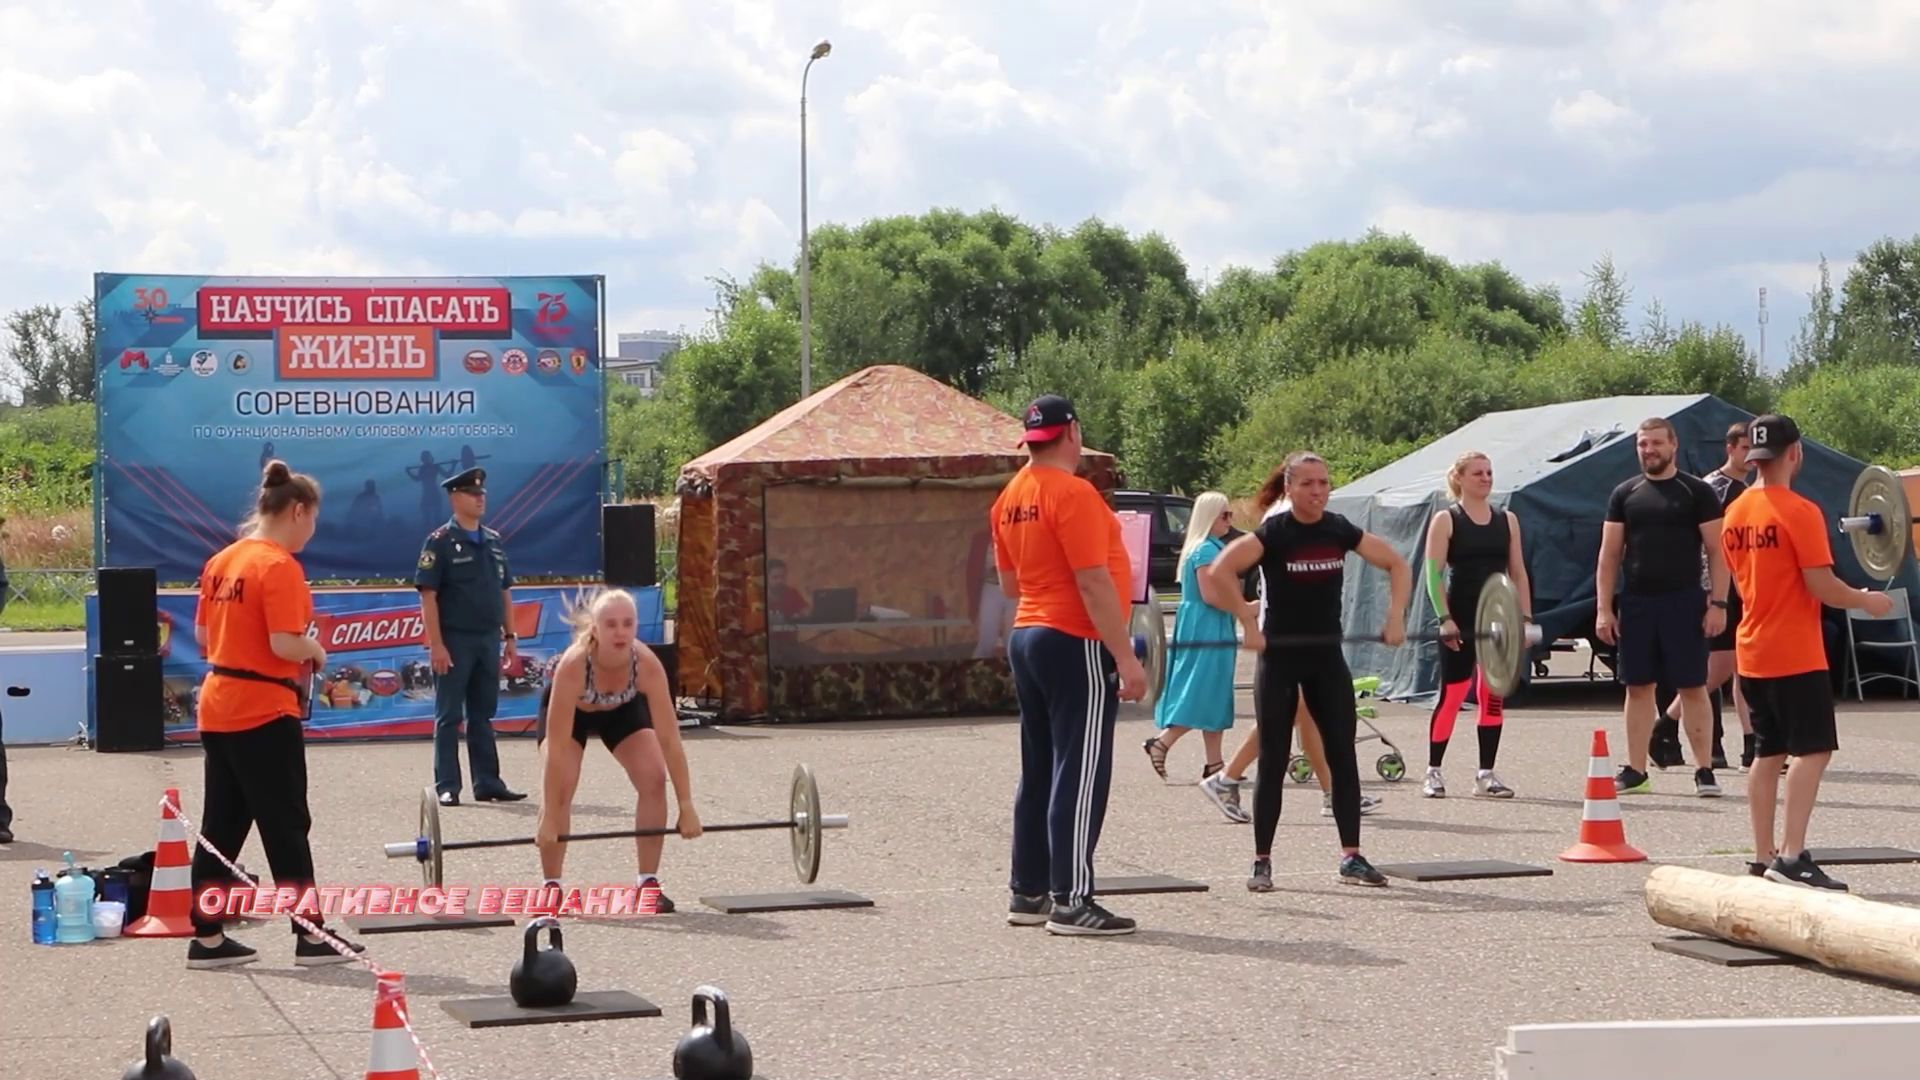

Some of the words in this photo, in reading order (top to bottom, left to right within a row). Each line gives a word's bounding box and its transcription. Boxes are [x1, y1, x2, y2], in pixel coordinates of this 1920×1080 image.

[133, 287, 168, 309] 30
[210, 295, 351, 323] НАУЧИСЬ
[366, 295, 500, 323] СПАСАТЬ
[535, 292, 568, 324] 75
[288, 334, 426, 369] ЖИЗНЬ
[236, 390, 475, 415] СОРЕВНОВАНИЯ
[193, 426, 213, 438] ПО
[216, 425, 352, 438] ФУНКЦИОНАЛЬНОМУ
[355, 425, 425, 437] СИЛОВОМУ
[429, 424, 516, 437] МНОГОБОРЬЮ
[1752, 426, 1768, 445] 13
[1001, 505, 1039, 526] УДЬЯ
[1725, 524, 1779, 552] СУДЬЯ
[331, 616, 425, 646] СПАСАТЬ
